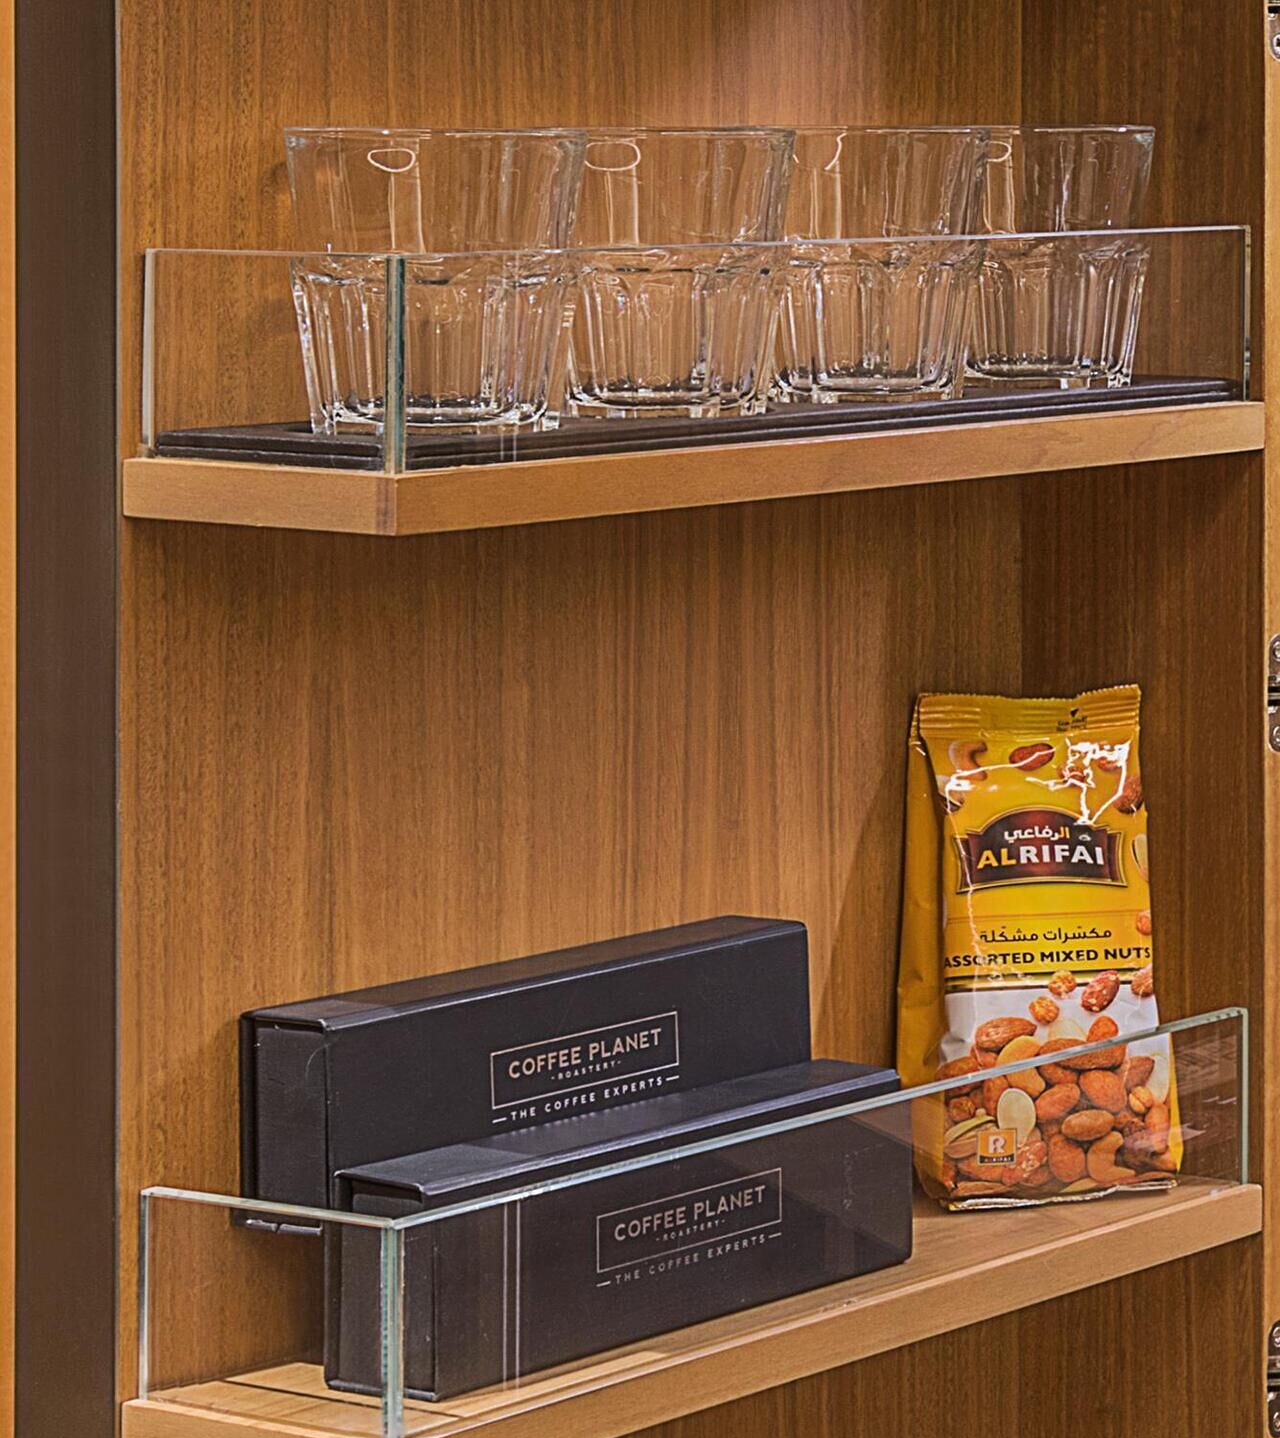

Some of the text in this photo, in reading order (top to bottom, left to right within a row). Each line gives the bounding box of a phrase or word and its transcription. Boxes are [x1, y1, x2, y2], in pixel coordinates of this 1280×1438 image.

[976, 845, 1104, 870] ALRIFAI
[1004, 826, 1070, 844] الرفاعي
[1040, 949, 1098, 963] MIXED
[1104, 947, 1150, 960] NUTS
[508, 1028, 662, 1079] COFFEE PLANET
[510, 1076, 663, 1121] THE COFFEE EXPERTS
[614, 1185, 766, 1241] COFFEE PLANET
[615, 1234, 765, 1284] THE COFFEE EXPERTS
